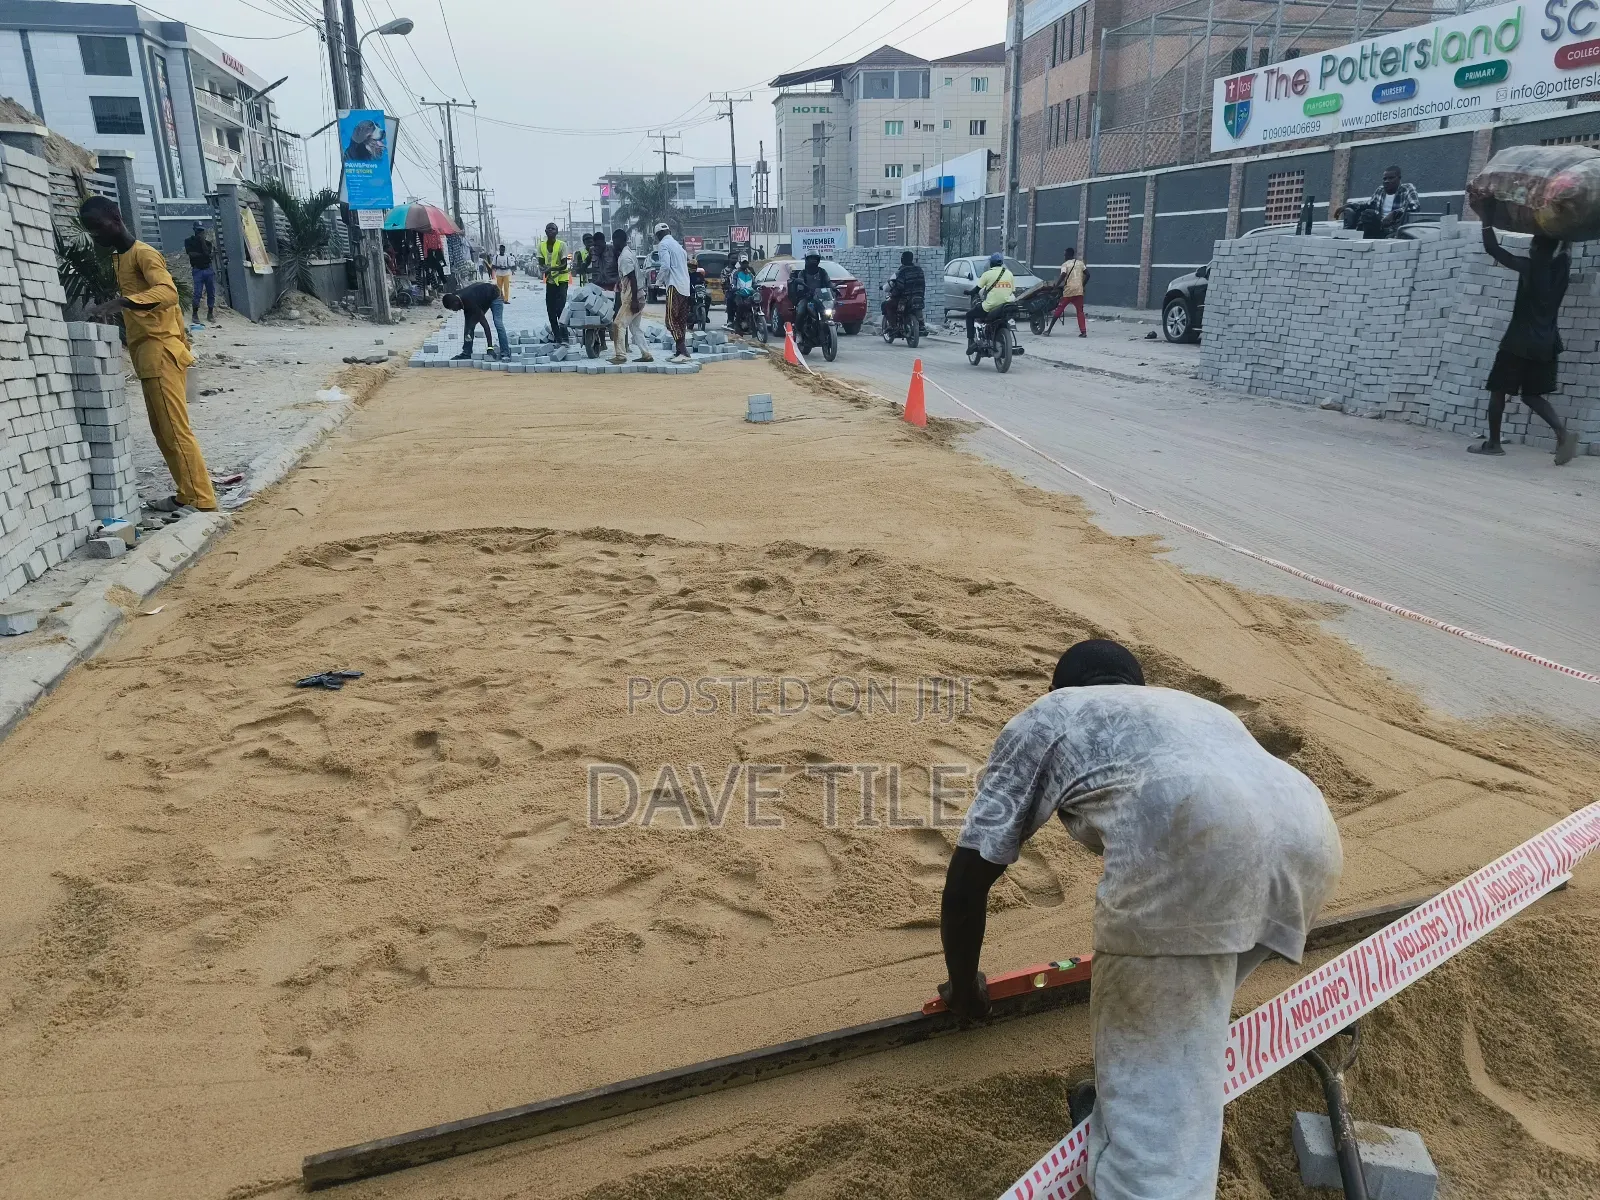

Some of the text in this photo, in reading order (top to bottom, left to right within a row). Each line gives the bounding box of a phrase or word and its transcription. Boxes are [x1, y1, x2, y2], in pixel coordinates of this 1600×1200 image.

[1263, 67, 1310, 102] The
[1319, 5, 1525, 91] Pottersland
[1567, 46, 1600, 61] COLLEG
[1464, 67, 1496, 81] PRIMARY
[1380, 85, 1407, 97] NURSERY
[792, 106, 833, 114] HOTEL
[1306, 99, 1337, 111] PLAYGROUP
[1341, 95, 1481, 128] www.potterslandschool.com
[1268, 120, 1321, 140] 09090406699
[1291, 975, 1350, 1031] CAUTION
[1393, 914, 1448, 965] CAUTION
[1482, 861, 1536, 906] CAUTION
